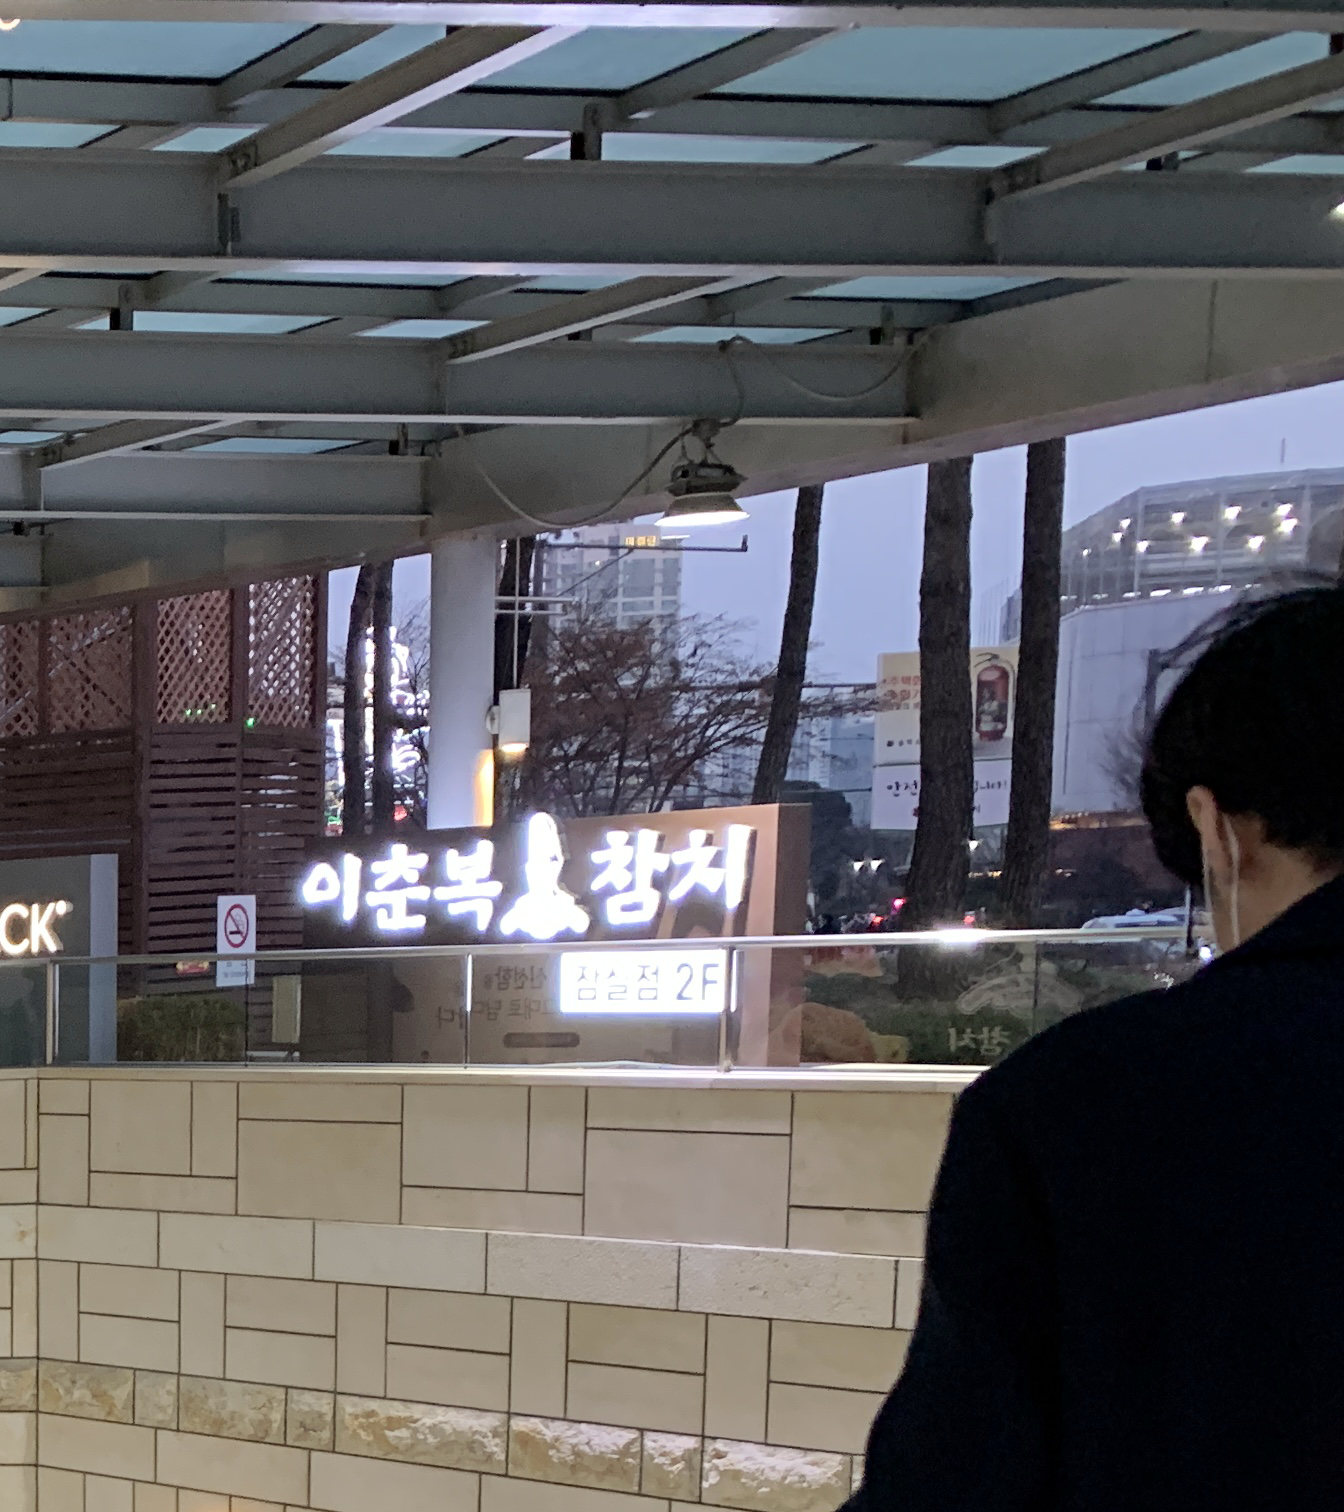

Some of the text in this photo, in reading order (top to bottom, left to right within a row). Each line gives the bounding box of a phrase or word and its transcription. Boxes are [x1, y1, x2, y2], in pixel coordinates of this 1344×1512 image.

[300, 824, 752, 933] 이춘복 참치
[577, 963, 720, 1001] 잠실점 2F
